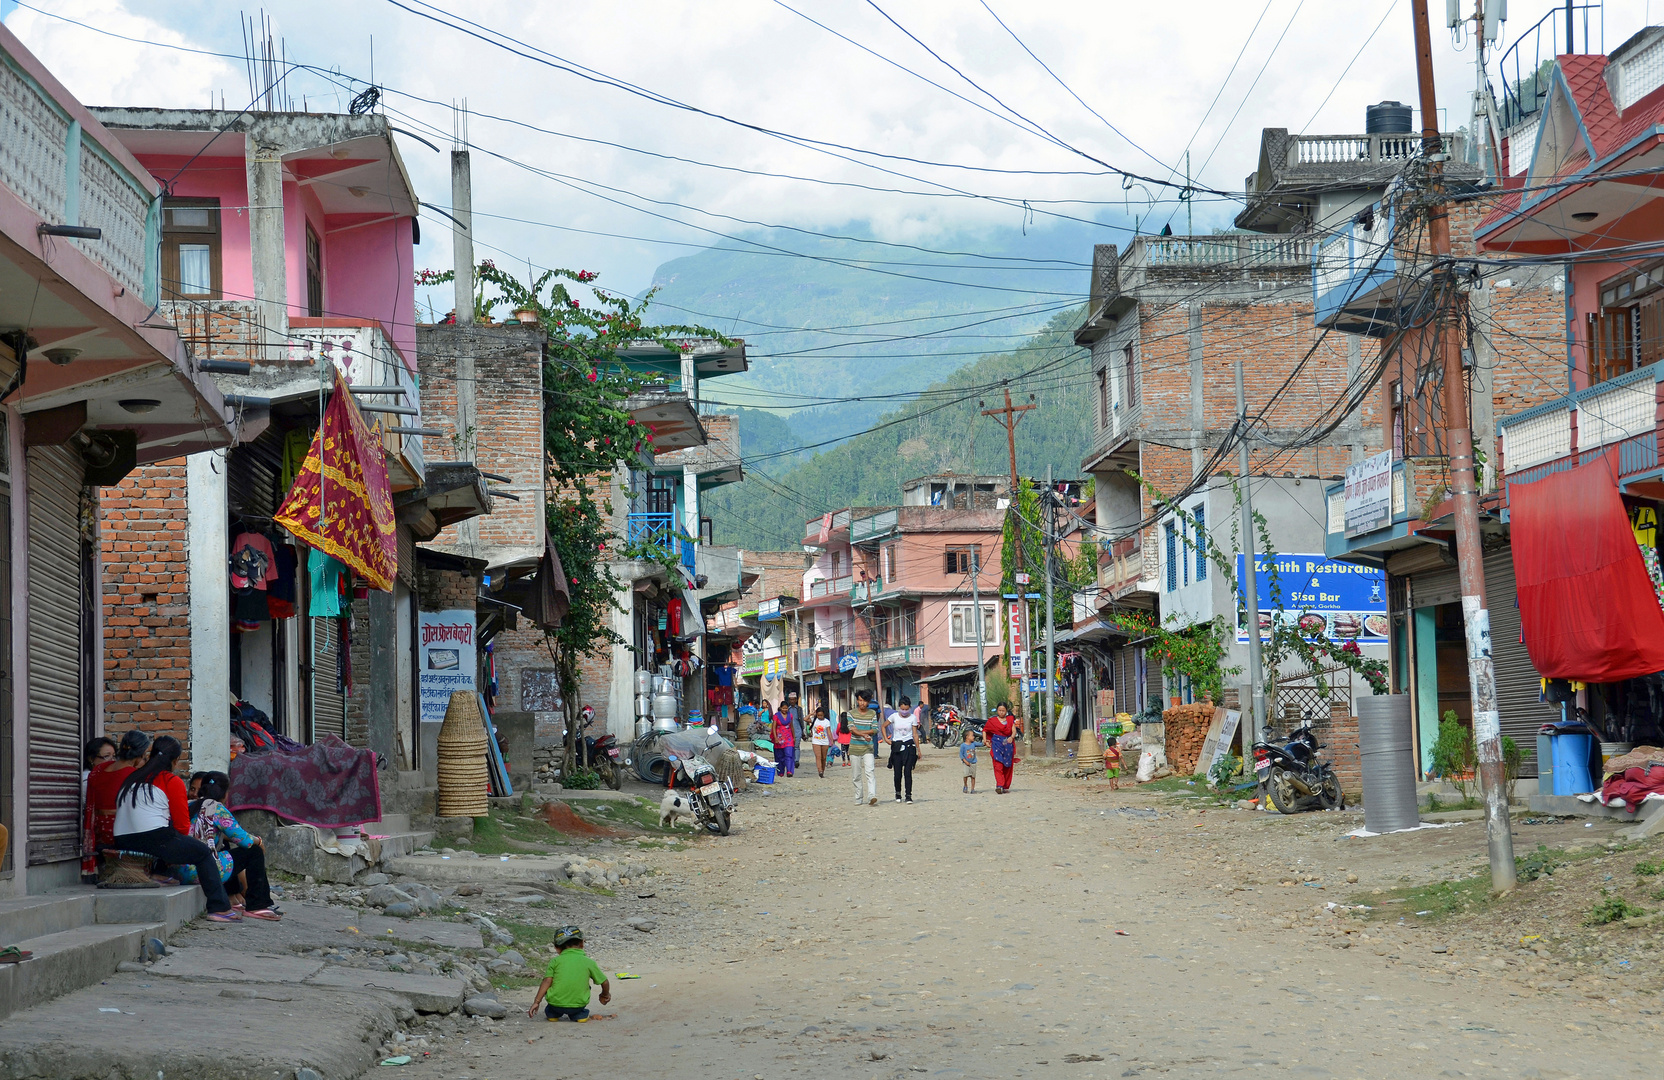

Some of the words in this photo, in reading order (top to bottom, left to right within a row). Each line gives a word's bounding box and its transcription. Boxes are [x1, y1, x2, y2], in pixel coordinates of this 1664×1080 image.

[1311, 578, 1320, 587] &
[1291, 592, 1315, 602] Sisa
[1319, 592, 1341, 602] Bar
[452, 622, 473, 646] बेकरी
